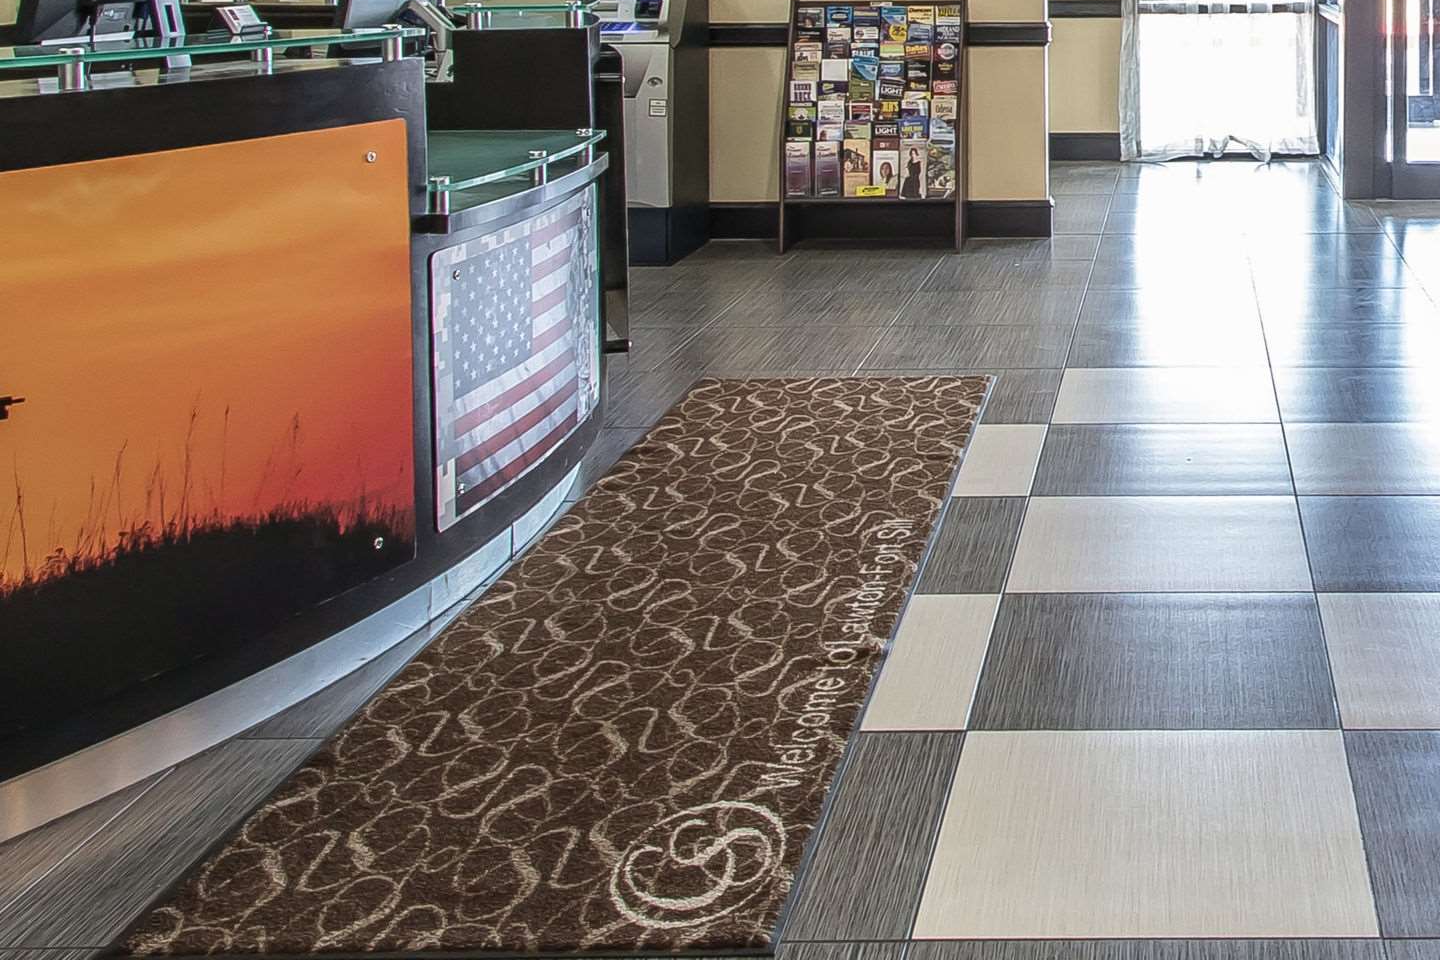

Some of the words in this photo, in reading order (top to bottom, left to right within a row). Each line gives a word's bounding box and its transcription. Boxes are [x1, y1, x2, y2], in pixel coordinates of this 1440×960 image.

[880, 86, 903, 96] LIGHT
[875, 127, 897, 136] LIGHT
[760, 677, 845, 786] Welcome
[816, 648, 857, 671] to
[877, 519, 914, 540] Sill
